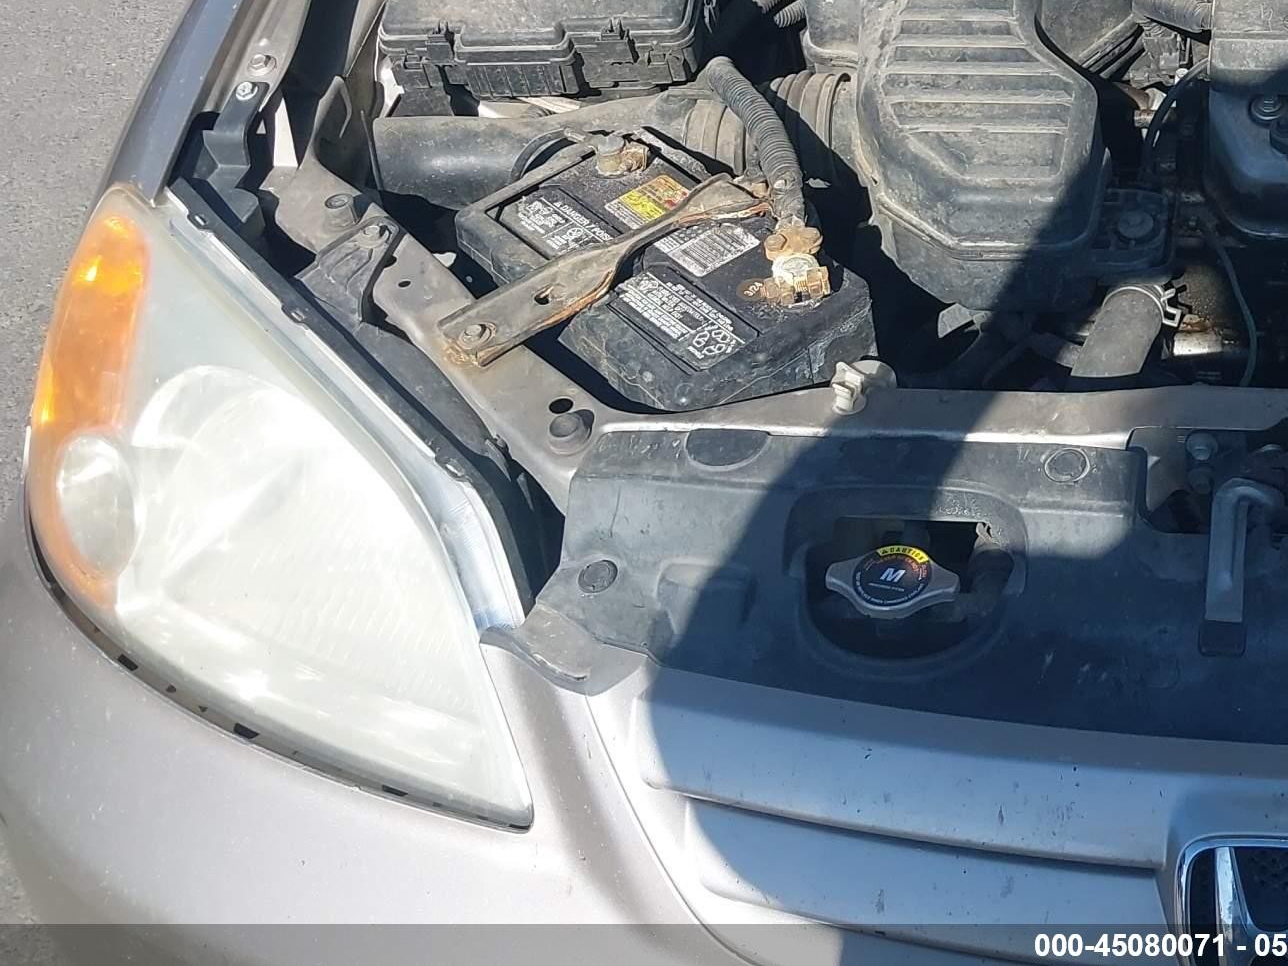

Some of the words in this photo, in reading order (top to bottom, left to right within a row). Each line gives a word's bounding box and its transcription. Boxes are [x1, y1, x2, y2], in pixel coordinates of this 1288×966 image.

[560, 205, 590, 226] DANGER
[591, 227, 614, 242] POIS
[743, 281, 763, 297] 3/24
[889, 547, 925, 561] CAUTION
[879, 567, 906, 583] M
